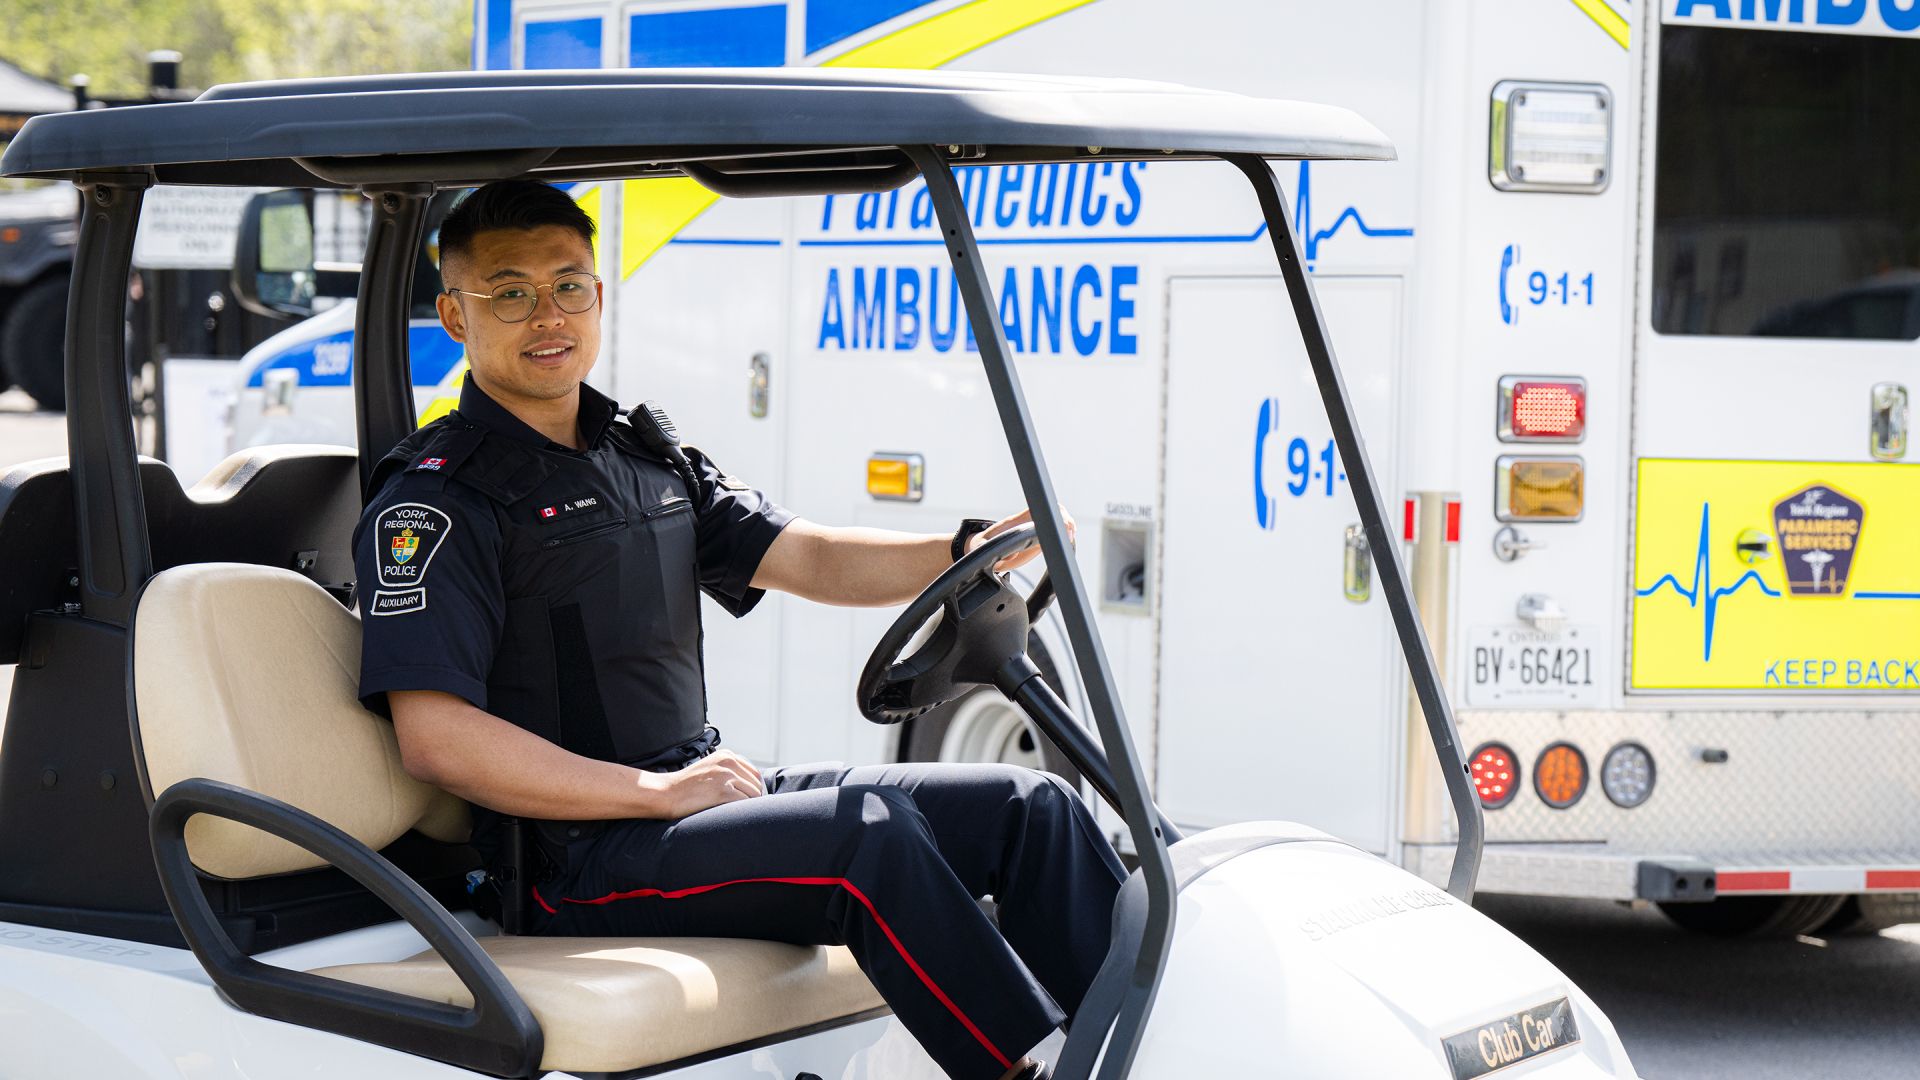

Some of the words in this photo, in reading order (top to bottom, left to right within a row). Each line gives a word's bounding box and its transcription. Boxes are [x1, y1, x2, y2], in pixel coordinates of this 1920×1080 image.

[1528, 271, 1594, 305] 9-1-1
[817, 264, 1139, 356] AMBUANCE
[1287, 437, 1346, 497] 9-1-
[564, 503, 574, 512] A.
[574, 497, 597, 509] WANG
[395, 509, 429, 521] YORK
[384, 520, 437, 532] REGIONAL
[1778, 518, 1858, 535] PARAMEDIC
[1784, 534, 1853, 551] SERVICES
[384, 565, 417, 577] POLICE
[379, 594, 419, 608] AUXILIARY
[1475, 647, 1504, 684] BV
[1520, 647, 1592, 685] 66421
[1765, 659, 1838, 685] KEEP
[1847, 659, 1920, 685] BACK
[37, 936, 153, 957] STEP
[1477, 1021, 1524, 1068] Club
[1521, 1014, 1556, 1052] Car
